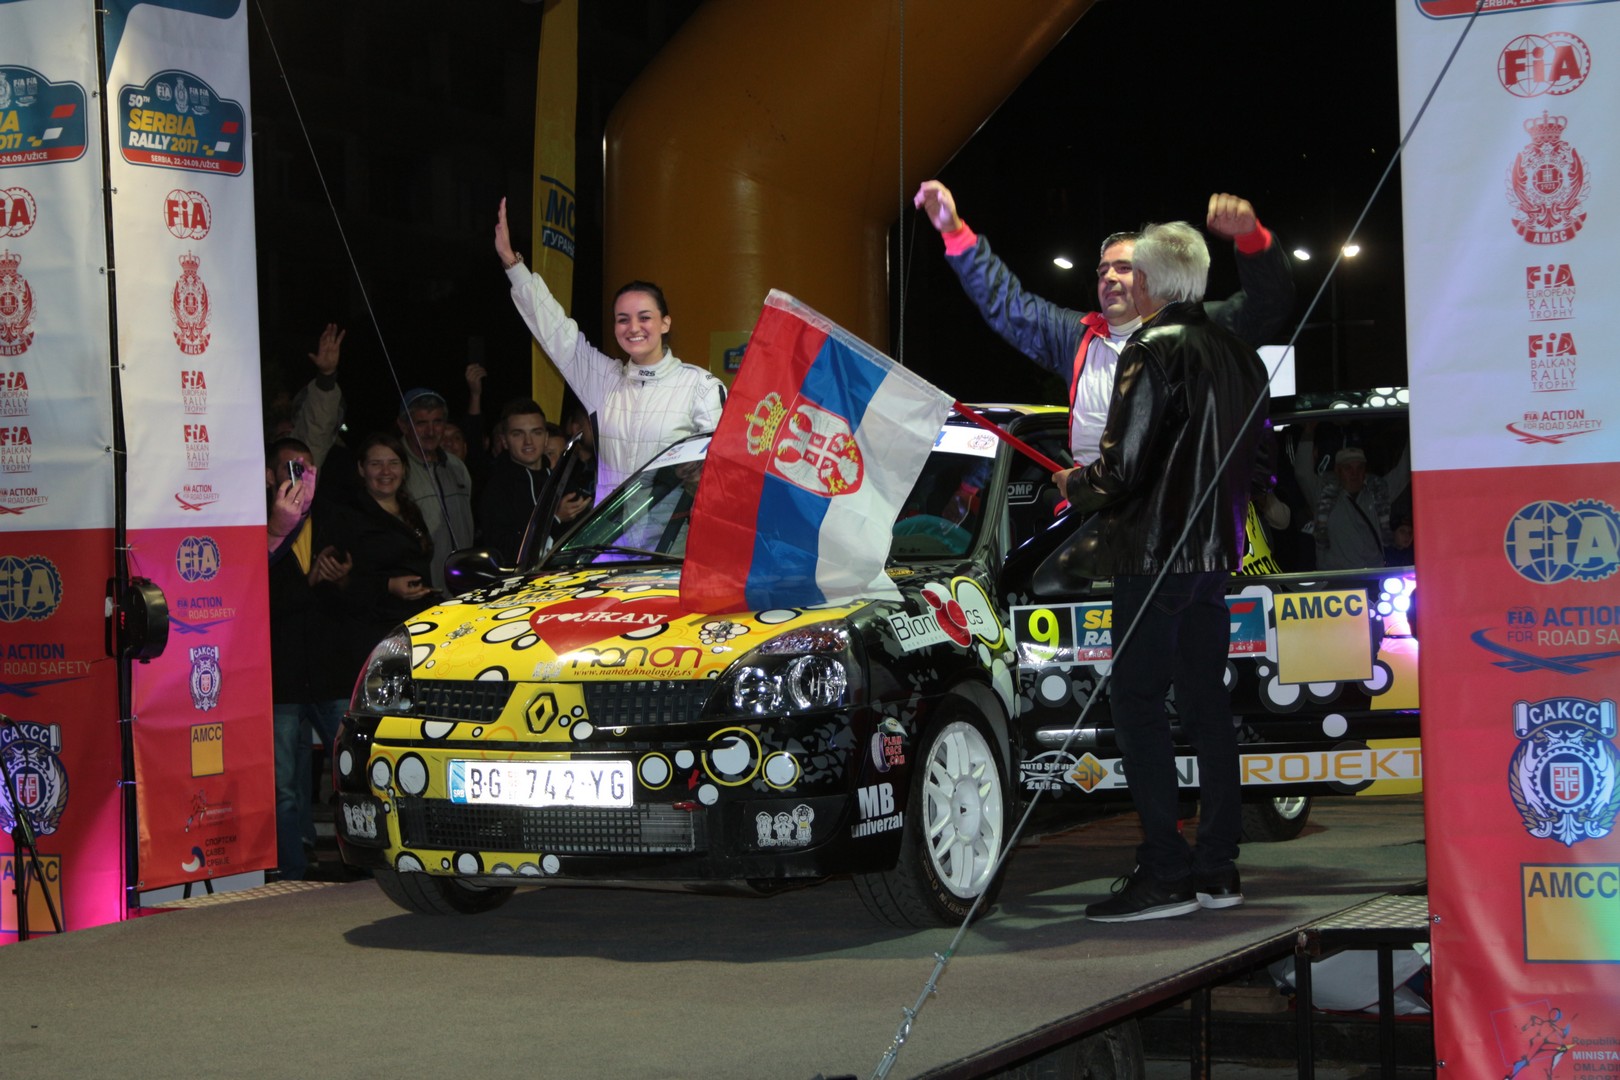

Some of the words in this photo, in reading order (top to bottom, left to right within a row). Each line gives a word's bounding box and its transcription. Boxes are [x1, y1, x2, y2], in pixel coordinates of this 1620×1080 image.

[128, 108, 196, 137] SERBIA
[0, 133, 23, 150] 017
[129, 131, 171, 150] RALLY
[170, 137, 199, 153] 2017
[1526, 287, 1576, 298] EUROPEAN
[1528, 297, 1575, 310] RALLY
[1530, 309, 1573, 319] TROPHY
[1531, 358, 1576, 369] BALKAN
[1531, 368, 1577, 381] RALLY
[1532, 380, 1575, 390] TROPHY
[183, 397, 207, 405] RALLY
[1541, 409, 1585, 421] ACTION
[1539, 422, 1564, 431] ROAD
[1567, 419, 1602, 430] SAFETY
[1, 455, 31, 464] RALLY
[187, 453, 209, 461] RALLY
[2, 464, 31, 472] TROPHY
[9, 488, 37, 496] ACTION
[192, 484, 212, 492] ACTION
[1008, 484, 1033, 496] OMP
[191, 597, 223, 608] ACTION
[189, 609, 209, 619] ROAD
[210, 607, 236, 618] SAFETY
[890, 607, 941, 641] Bioni
[1028, 608, 1059, 660] 9
[1507, 630, 1534, 642] FOR
[1538, 629, 1590, 646] ROAD
[8, 643, 65, 659] ACTION
[4, 662, 36, 675] ROAD
[40, 660, 91, 675] SAFETY
[1019, 763, 1043, 771] AUTO
[1242, 749, 1422, 783] ROJEKT
[857, 782, 895, 820] MB
[851, 811, 904, 838] univerzal
[1574, 1063, 1620, 1072] OMLADI
